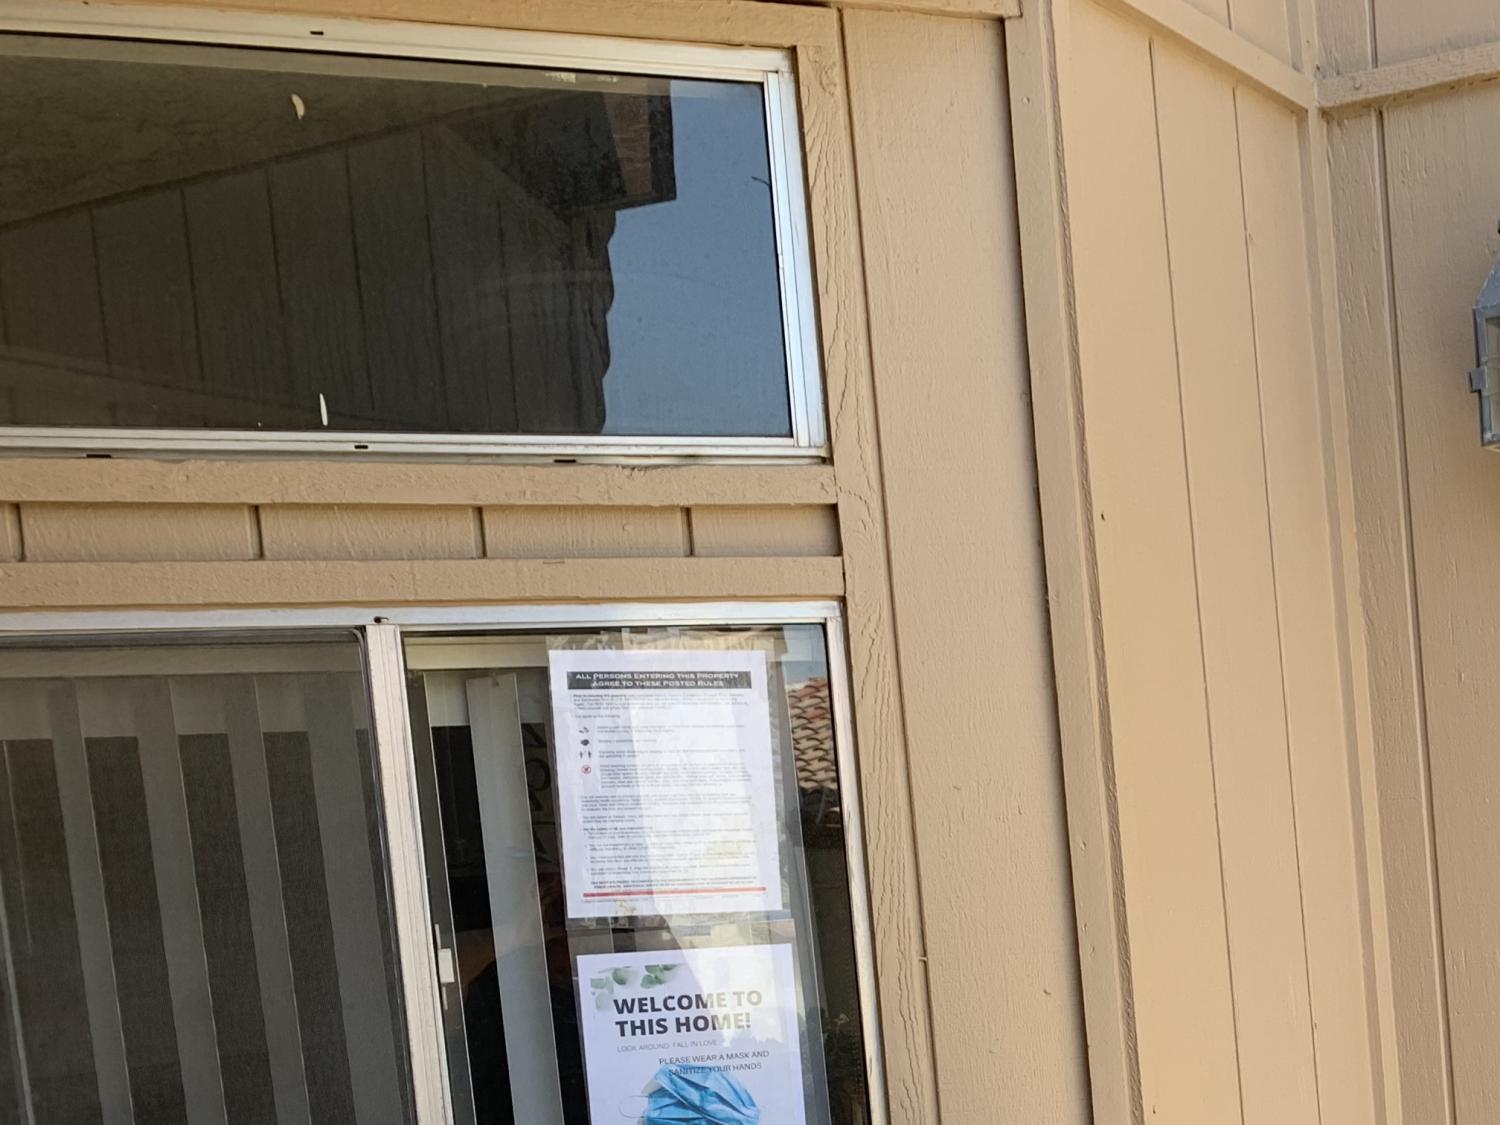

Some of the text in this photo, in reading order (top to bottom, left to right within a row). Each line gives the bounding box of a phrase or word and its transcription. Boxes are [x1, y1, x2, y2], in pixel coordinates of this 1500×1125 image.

[575, 672, 739, 680] ALL PERSONS ENTERING THIS PROPERTY
[592, 680, 621, 688] AGREE
[623, 680, 633, 688] TO
[634, 680, 661, 688] THESE
[663, 680, 696, 688] POSTED
[613, 990, 763, 1015] WELCOME TO
[615, 1012, 752, 1037] THIS HOME!
[617, 1045, 637, 1053] LOOK
[659, 1049, 770, 1065] PLEASE WEAR A MASK AND
[668, 1062, 762, 1076] SANITIZE YOUR HANDS
